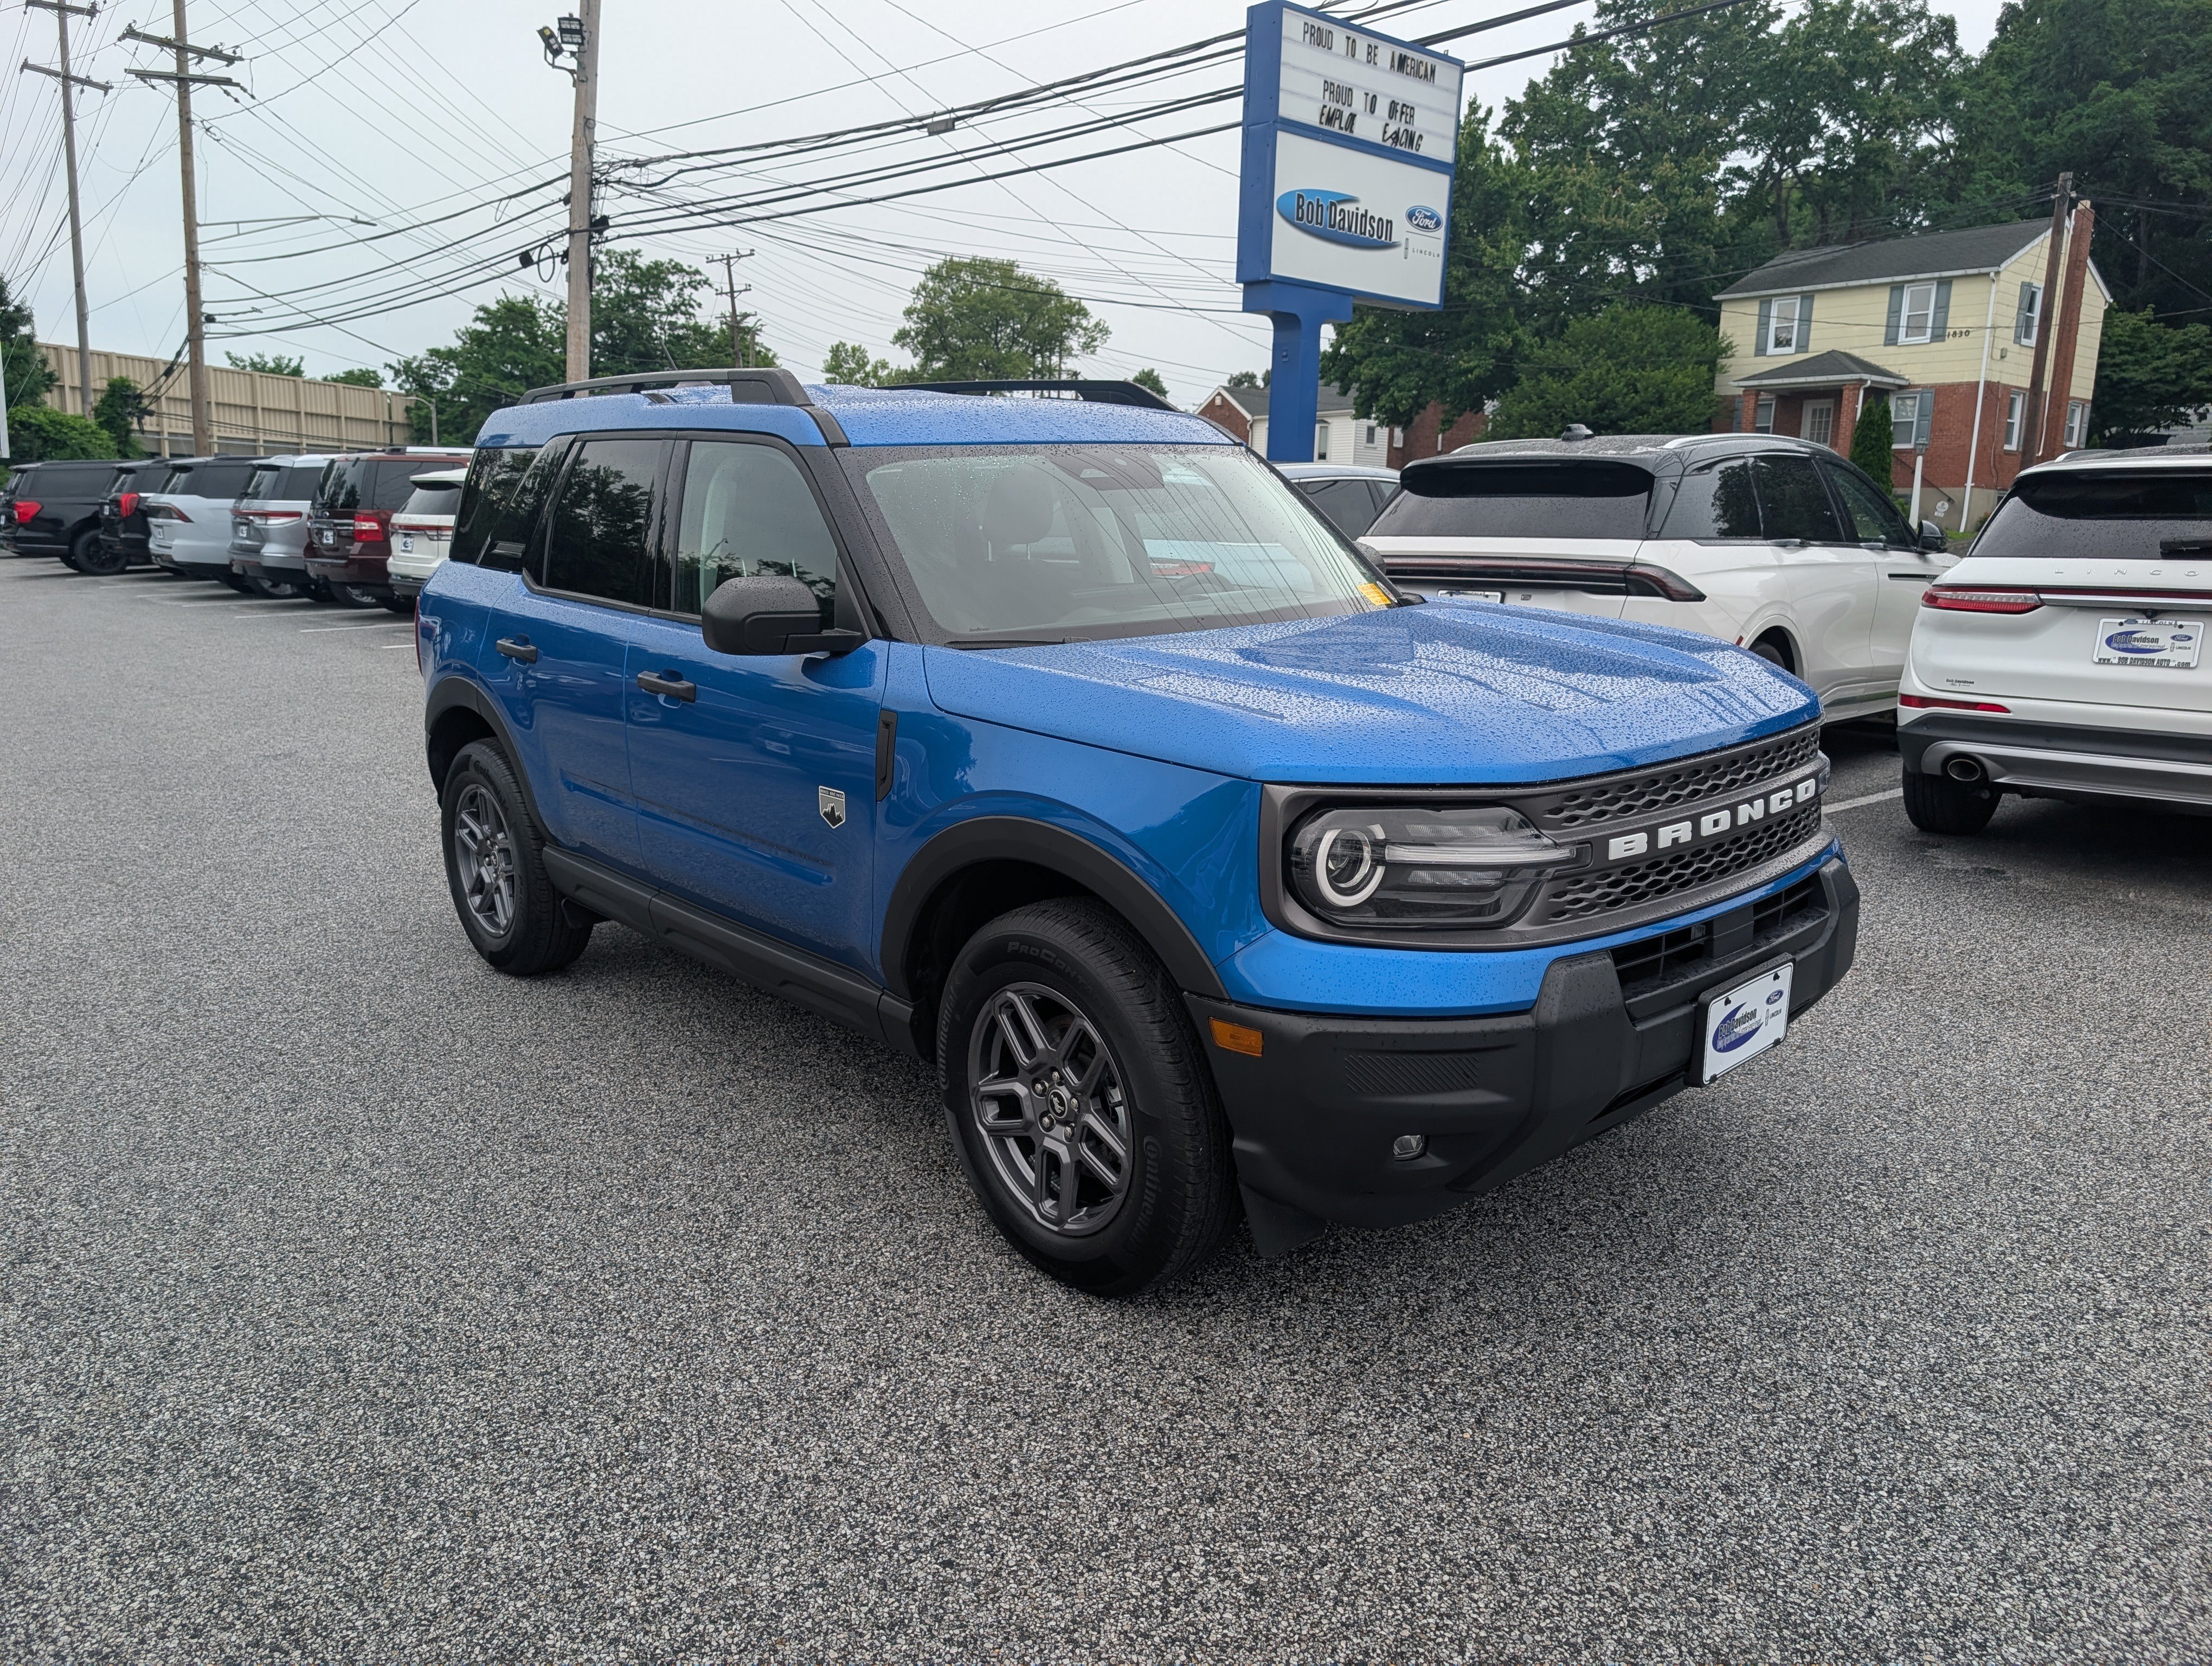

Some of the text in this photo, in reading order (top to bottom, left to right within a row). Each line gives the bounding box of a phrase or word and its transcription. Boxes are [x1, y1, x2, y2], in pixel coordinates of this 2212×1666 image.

[1303, 22, 1436, 84] PROUD TO BE AMERICAN
[1322, 80, 1415, 126] PROUD TO OFFER
[1295, 192, 1393, 242] Bob Davidson
[1412, 209, 1437, 229] Ford
[1412, 247, 1441, 258] LINCOLN
[1947, 329, 1970, 339] 1830
[2114, 635, 2159, 644] Bob Davidson
[2129, 657, 2155, 666] DAVIDSON
[2156, 658, 2171, 667] AUTO
[1608, 778, 1816, 861] BRONCO
[1769, 991, 1781, 1003] Ford
[1769, 1008, 1782, 1020] LINCOLN
[1719, 1020, 1731, 1039] Bob
[1731, 1008, 1757, 1031] Davidson
